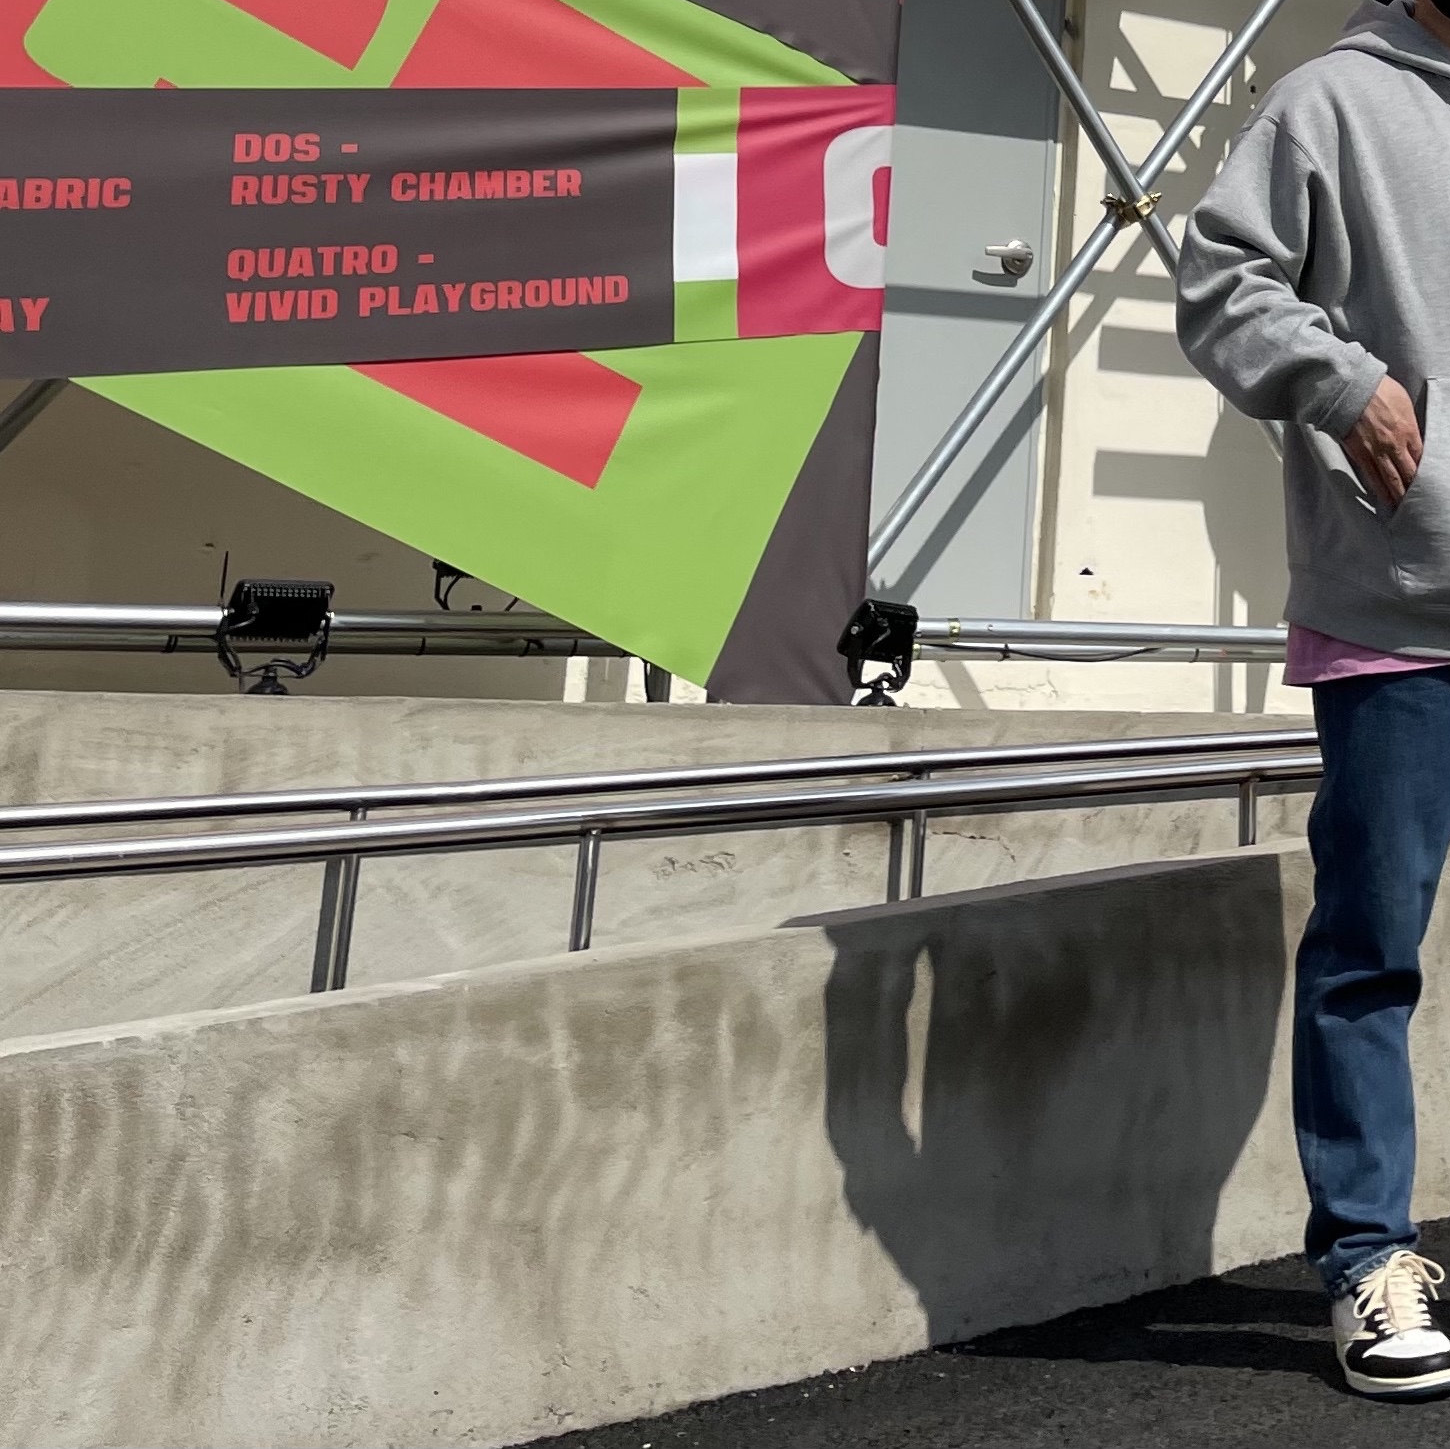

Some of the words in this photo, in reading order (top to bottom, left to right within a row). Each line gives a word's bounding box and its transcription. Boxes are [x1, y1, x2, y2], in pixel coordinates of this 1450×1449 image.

[232, 133, 321, 163] DOS
[230, 173, 371, 205] RUSTY
[391, 169, 582, 202] CHAMBER
[226, 244, 398, 281] QUATRO
[225, 288, 338, 323] VIVID
[359, 275, 629, 317] PLAYGROUND
